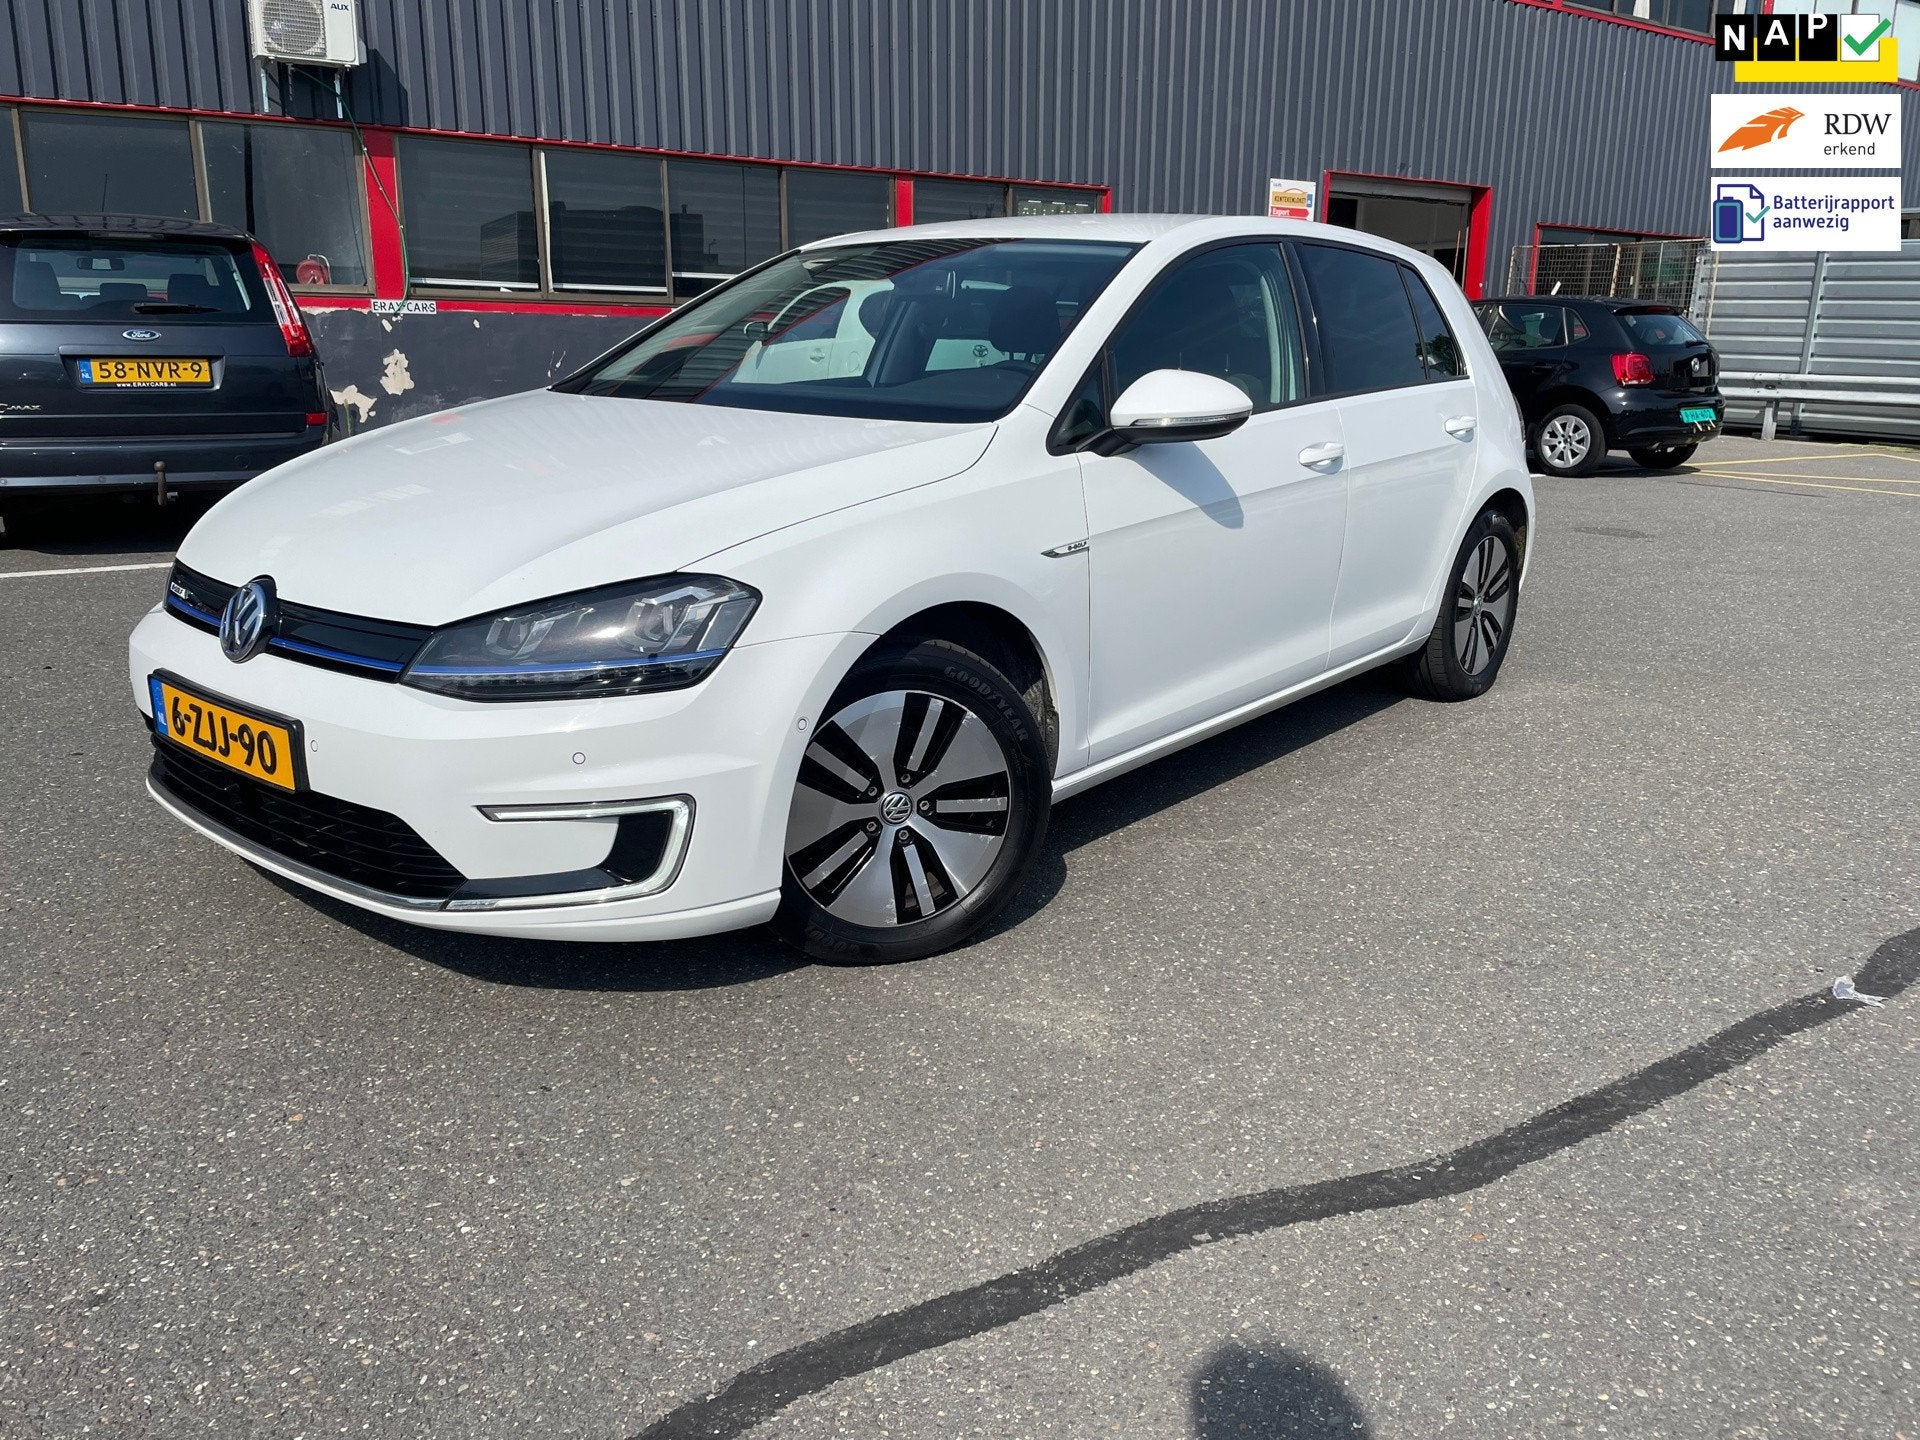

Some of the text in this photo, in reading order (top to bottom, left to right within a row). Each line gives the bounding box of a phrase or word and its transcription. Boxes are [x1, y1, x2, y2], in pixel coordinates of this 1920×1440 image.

[331, 3, 350, 11] AUX
[98, 362, 203, 379] 58-NVR-9
[171, 696, 278, 776] 6-ZJJ-90
